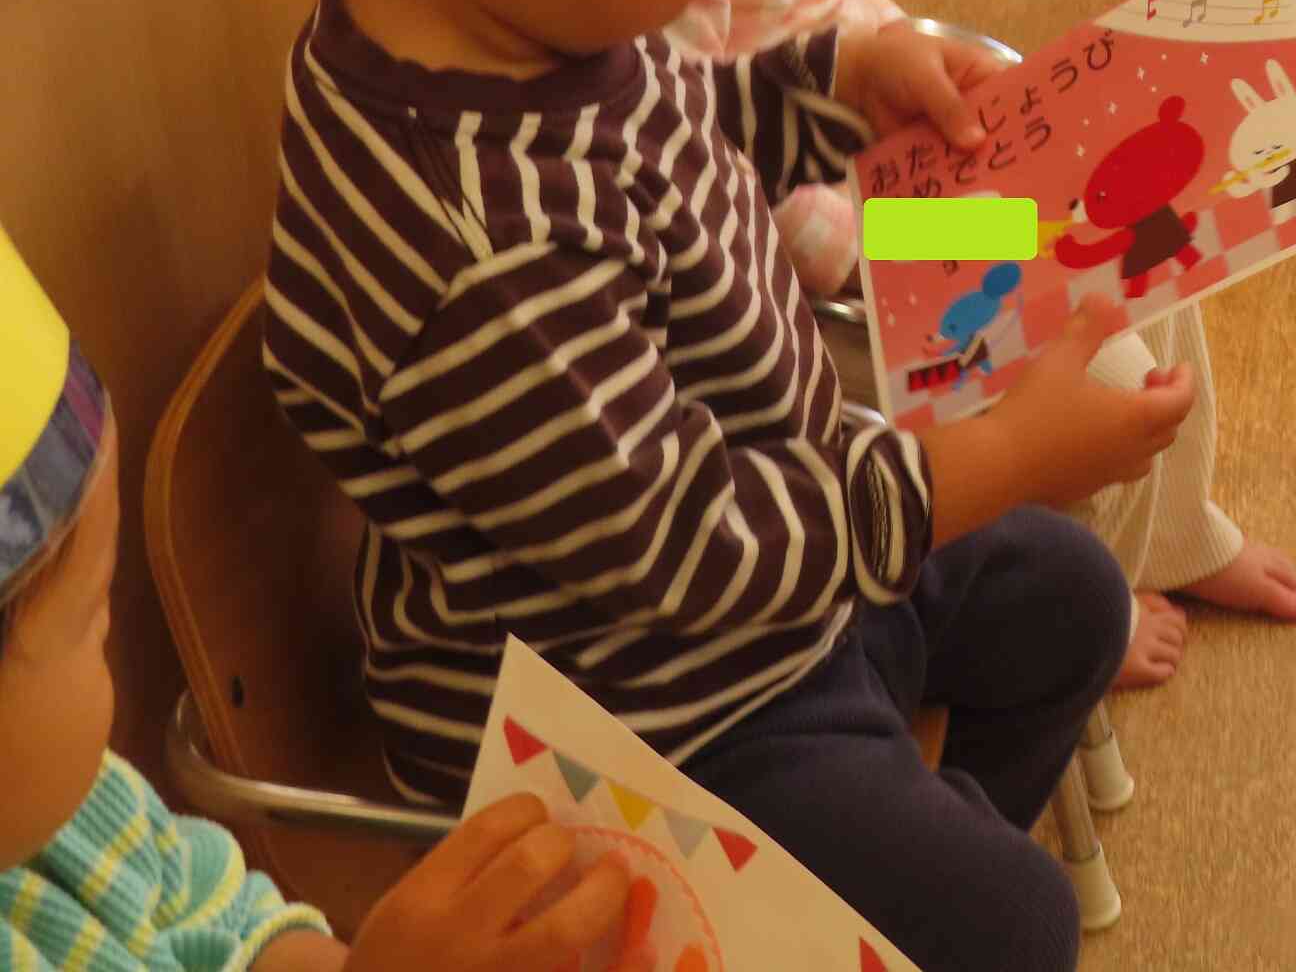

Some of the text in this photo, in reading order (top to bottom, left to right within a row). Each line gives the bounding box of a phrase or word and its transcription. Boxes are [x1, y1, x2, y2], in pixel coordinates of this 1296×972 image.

[871, 28, 1117, 194] おたじょうび
